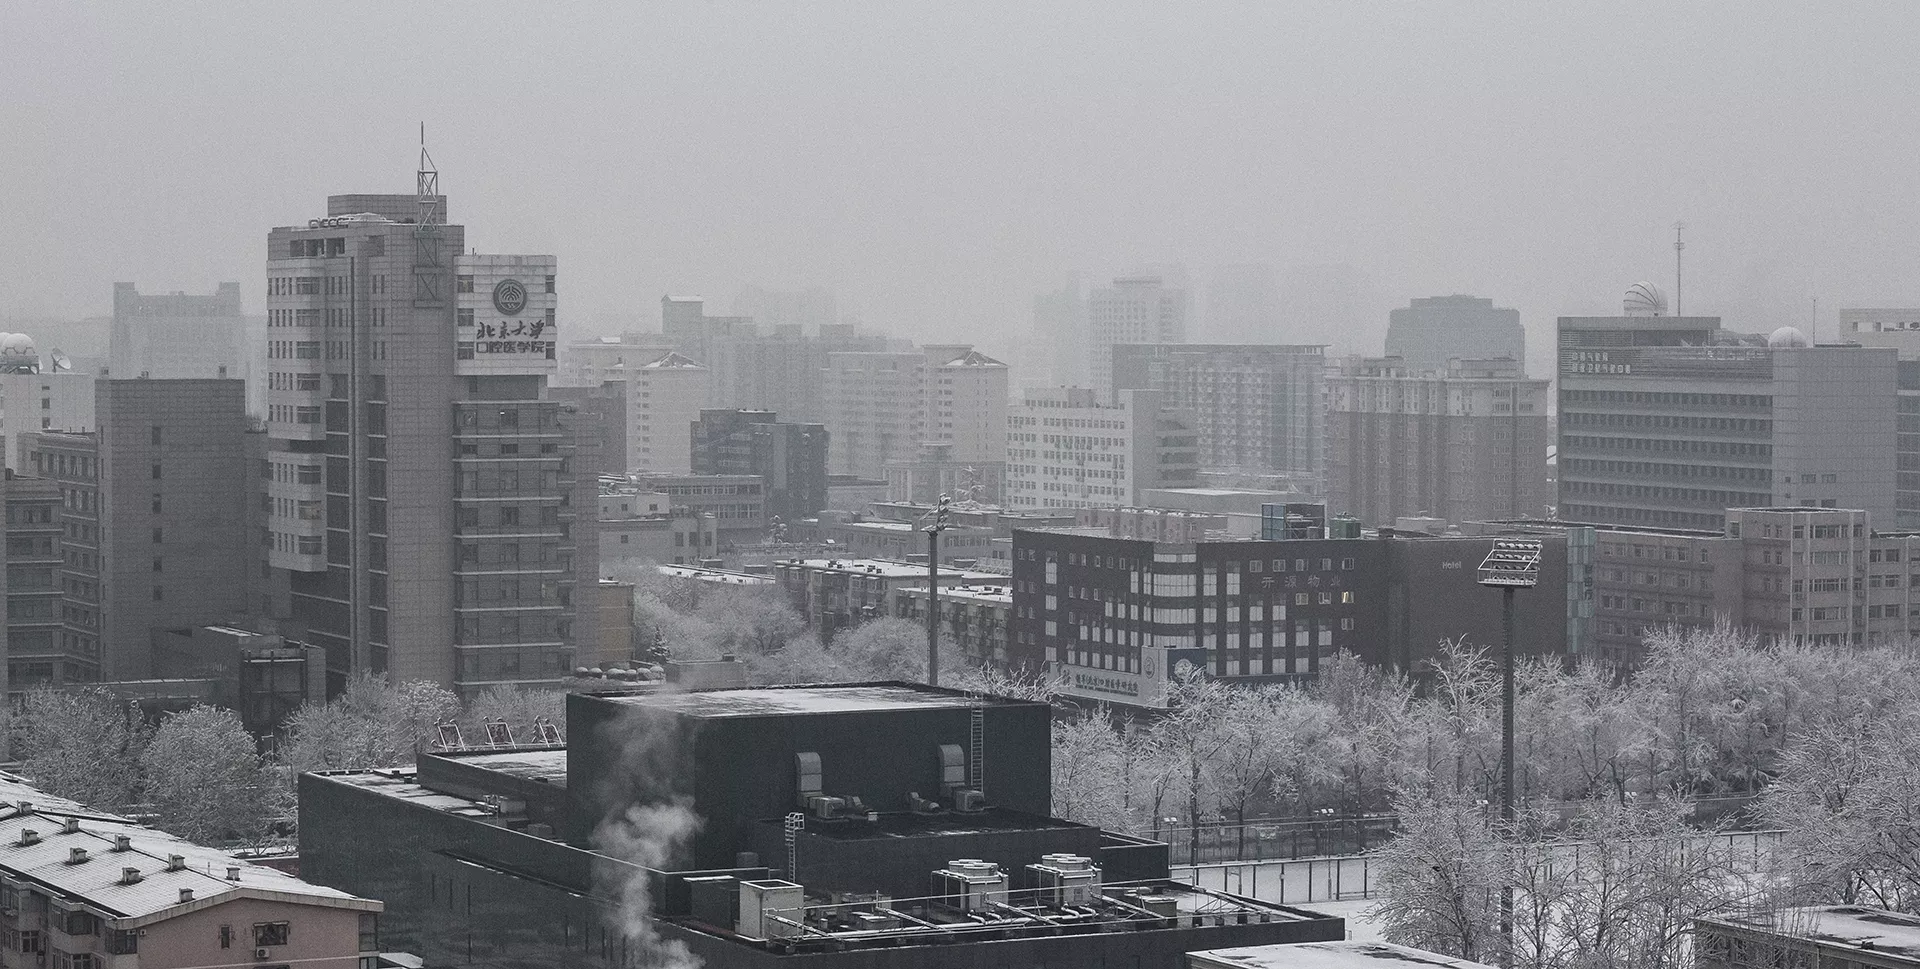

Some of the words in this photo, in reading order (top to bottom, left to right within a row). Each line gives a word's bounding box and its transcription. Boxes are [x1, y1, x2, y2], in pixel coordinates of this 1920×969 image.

[476, 320, 545, 340] 北京大学
[476, 341, 545, 354] 口腔医学院
